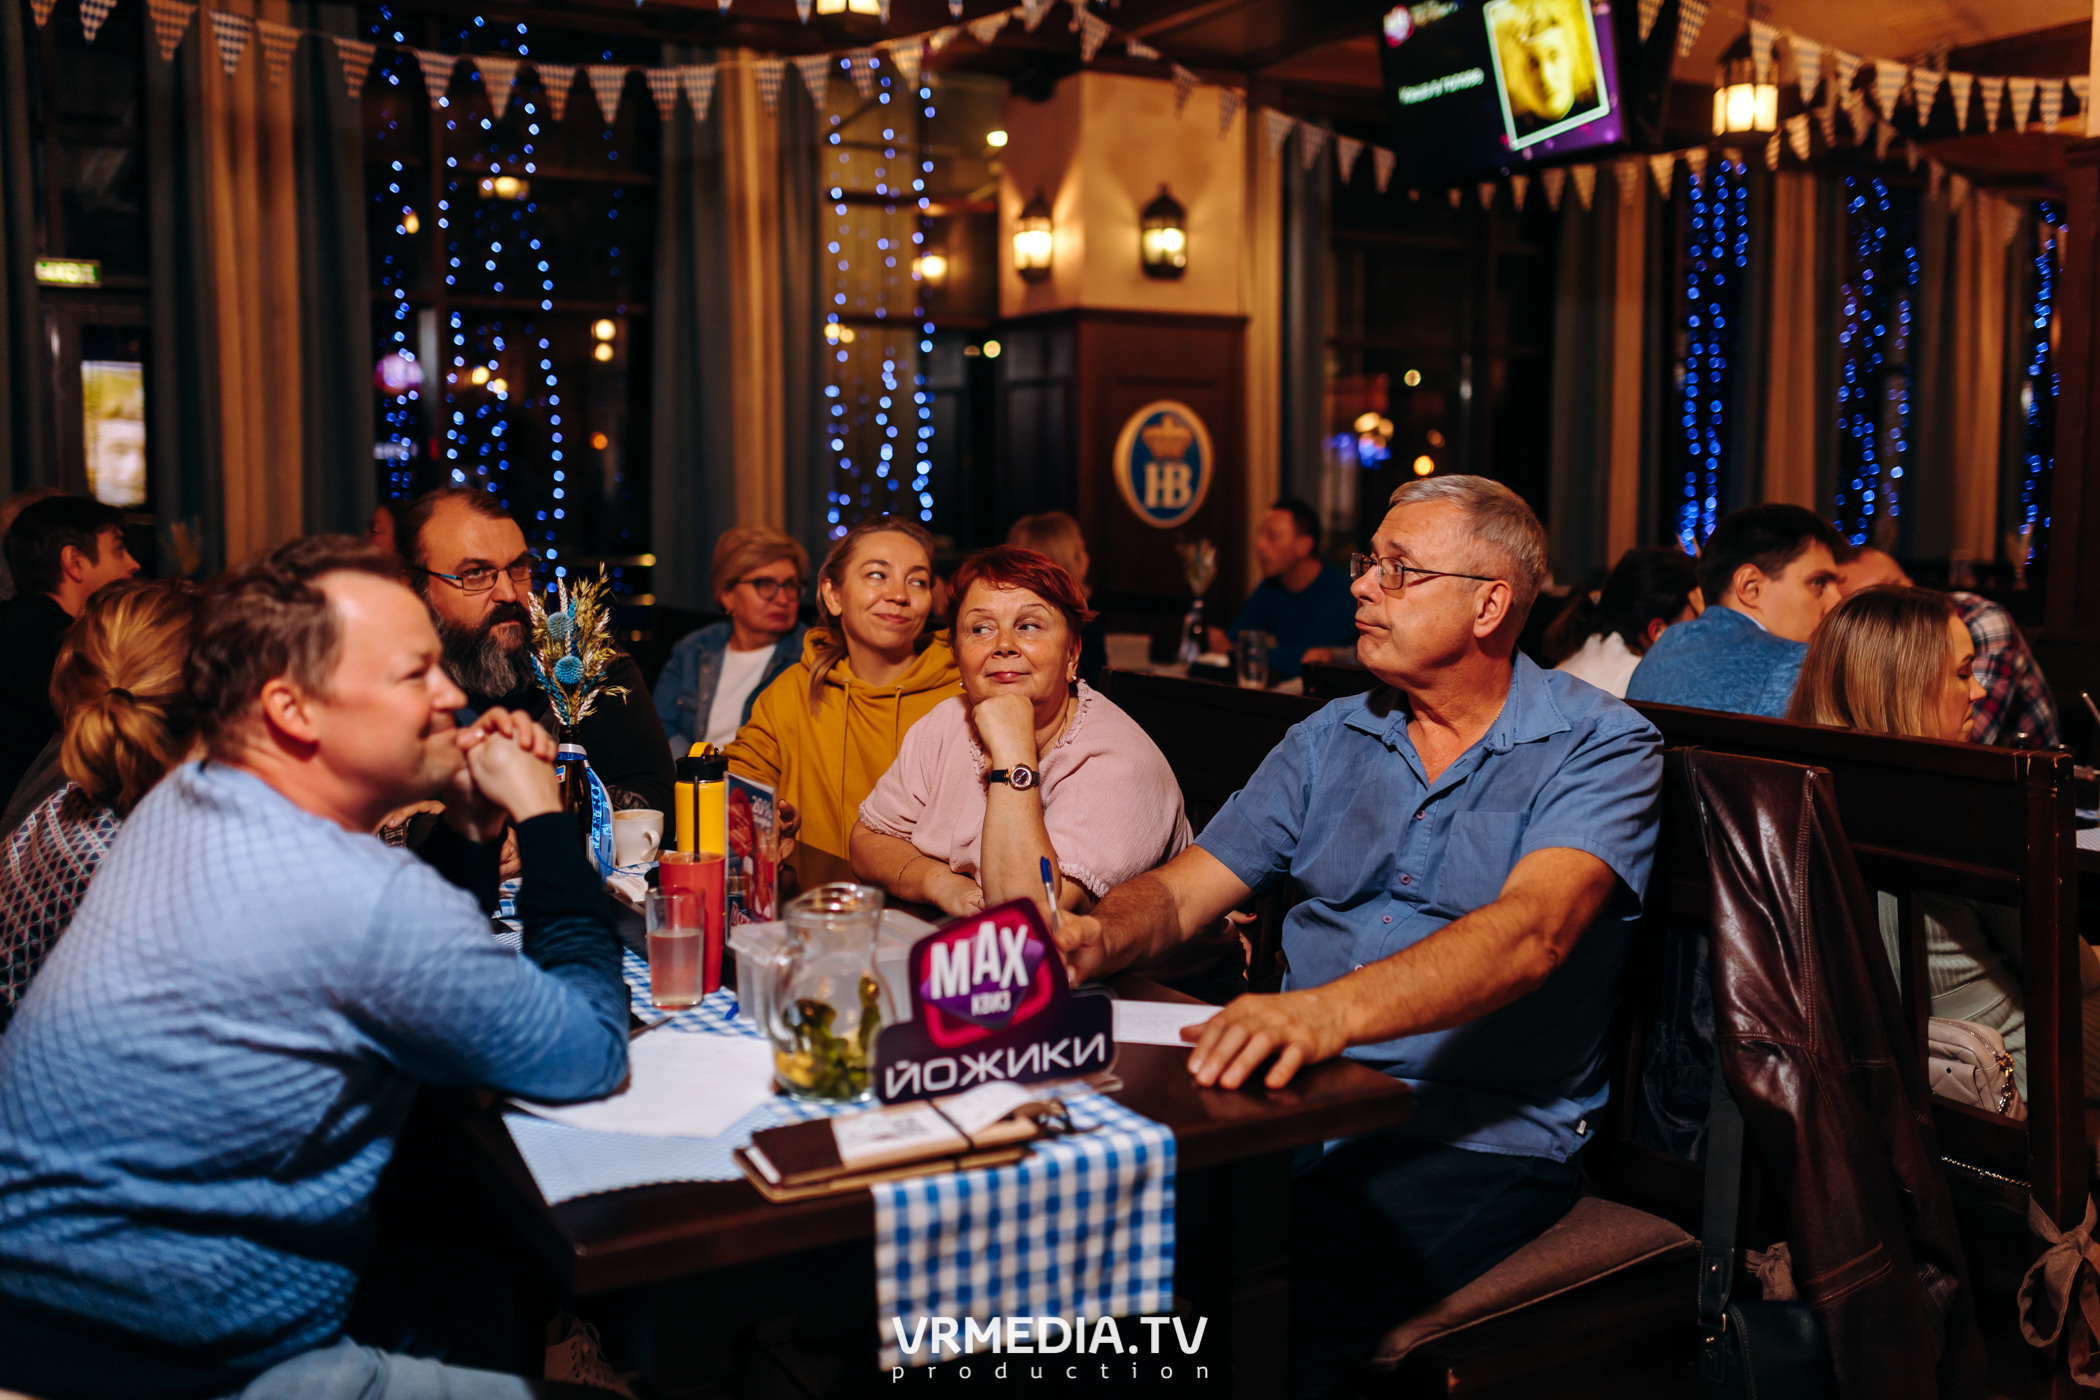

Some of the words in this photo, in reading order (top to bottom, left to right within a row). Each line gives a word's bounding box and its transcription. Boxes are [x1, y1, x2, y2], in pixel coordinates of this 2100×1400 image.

[1144, 462, 1192, 508] HB
[930, 920, 1029, 1000] MAX
[971, 989, 1011, 1016] КВИЗ
[885, 1032, 1106, 1099] ЙОЖИКИ
